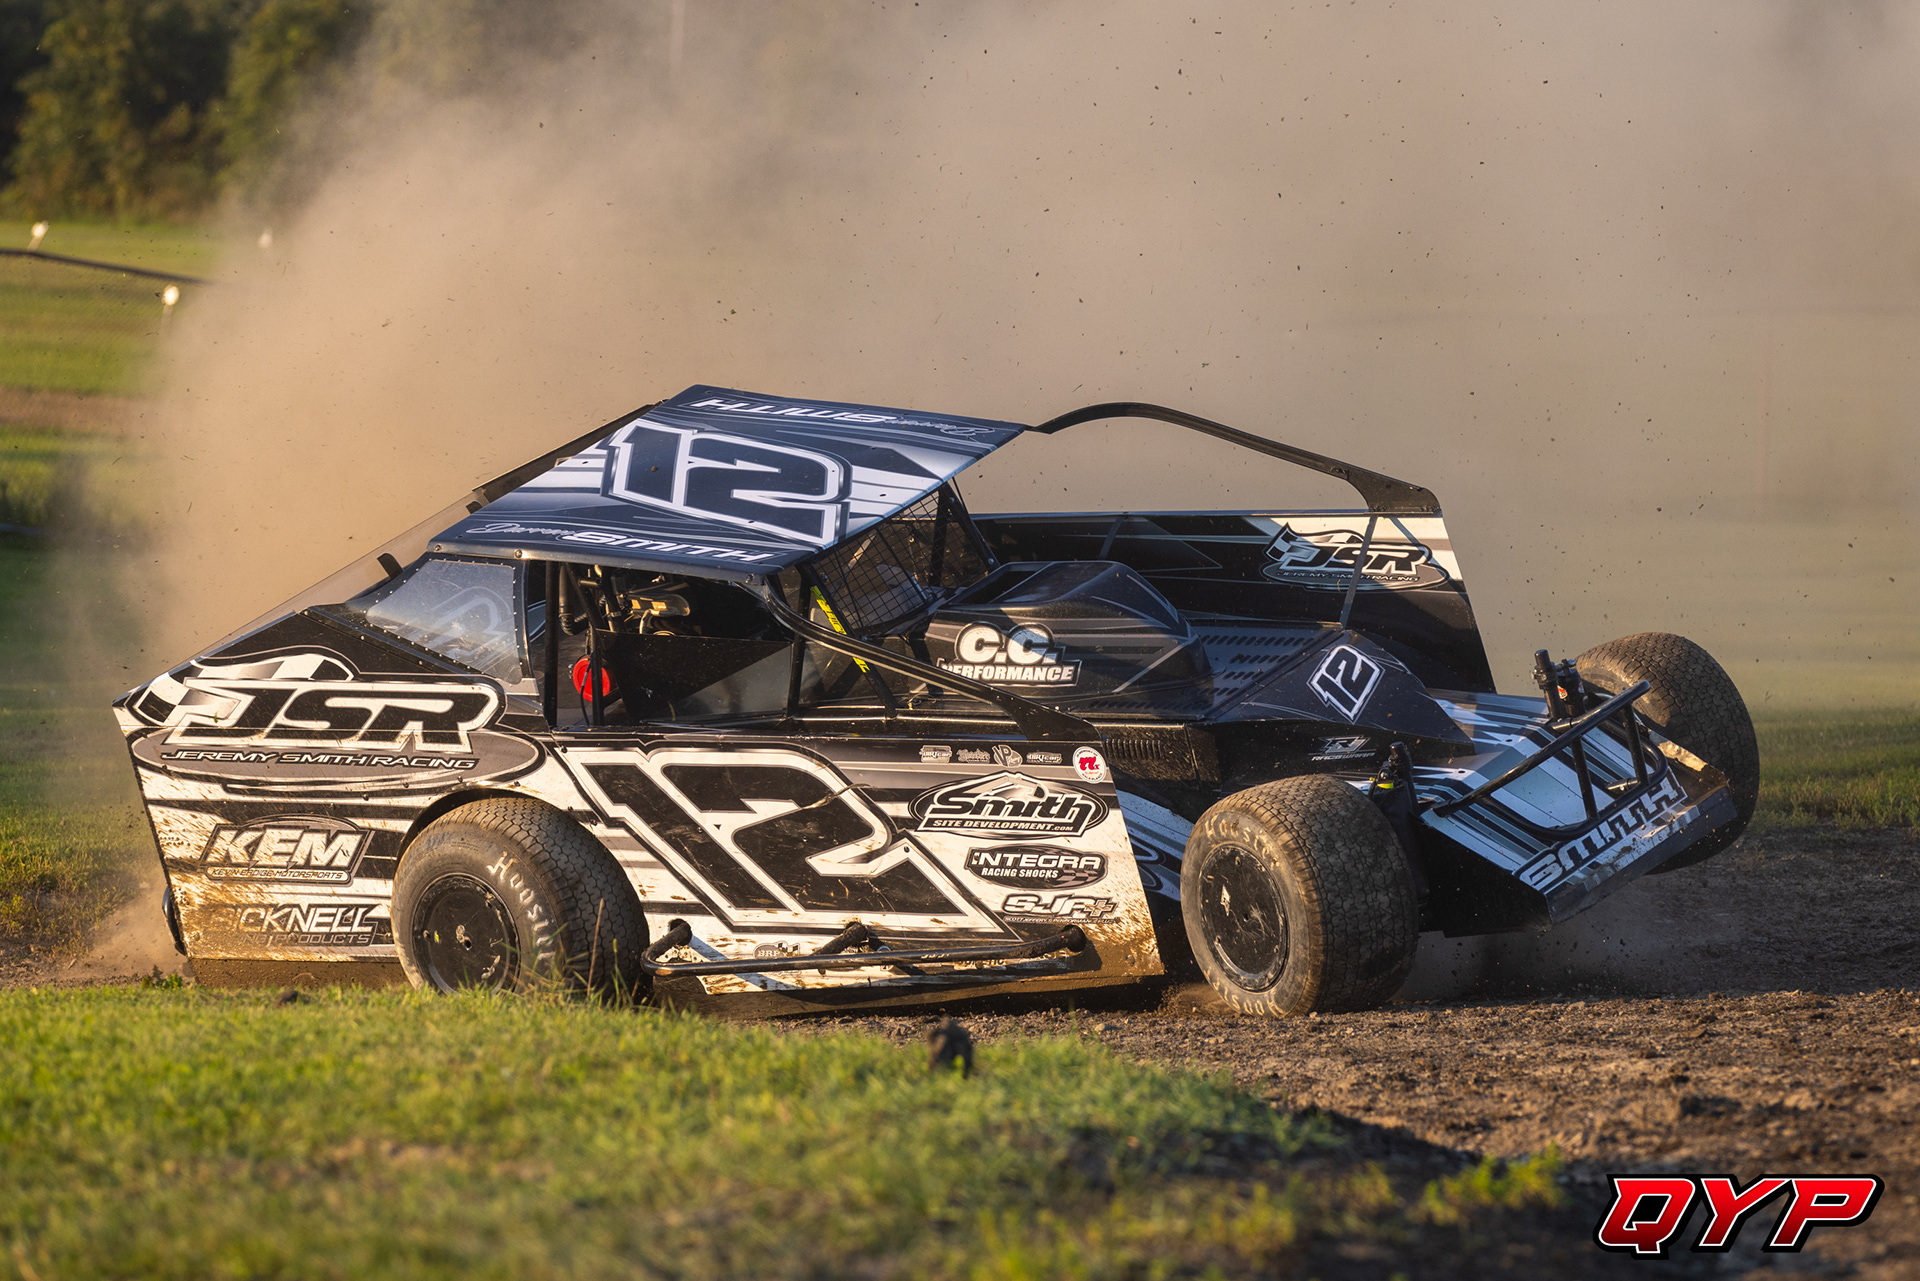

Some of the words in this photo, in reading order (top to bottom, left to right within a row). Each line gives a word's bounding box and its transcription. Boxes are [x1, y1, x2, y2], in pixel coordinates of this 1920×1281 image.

[690, 399, 898, 423] SMITH
[606, 418, 844, 550] 12
[561, 531, 775, 562] SMITH
[1279, 541, 1429, 575] JSR
[959, 624, 1058, 664] C.C.
[1310, 646, 1380, 720] 12
[165, 677, 499, 753] JSR
[162, 750, 276, 761] JEREMY
[279, 753, 367, 764] SMITH
[370, 757, 476, 769] RACING
[928, 786, 1093, 823] Smith
[562, 748, 1004, 927] 12
[932, 819, 962, 828] SITE
[1519, 776, 1680, 889] SMITH
[206, 829, 363, 868] KEM
[274, 870, 344, 879] MOTORSPORTS
[981, 867, 1017, 878] RACING
[1019, 868, 1059, 879] SHOCKS
[224, 907, 374, 932] ICKNELL
